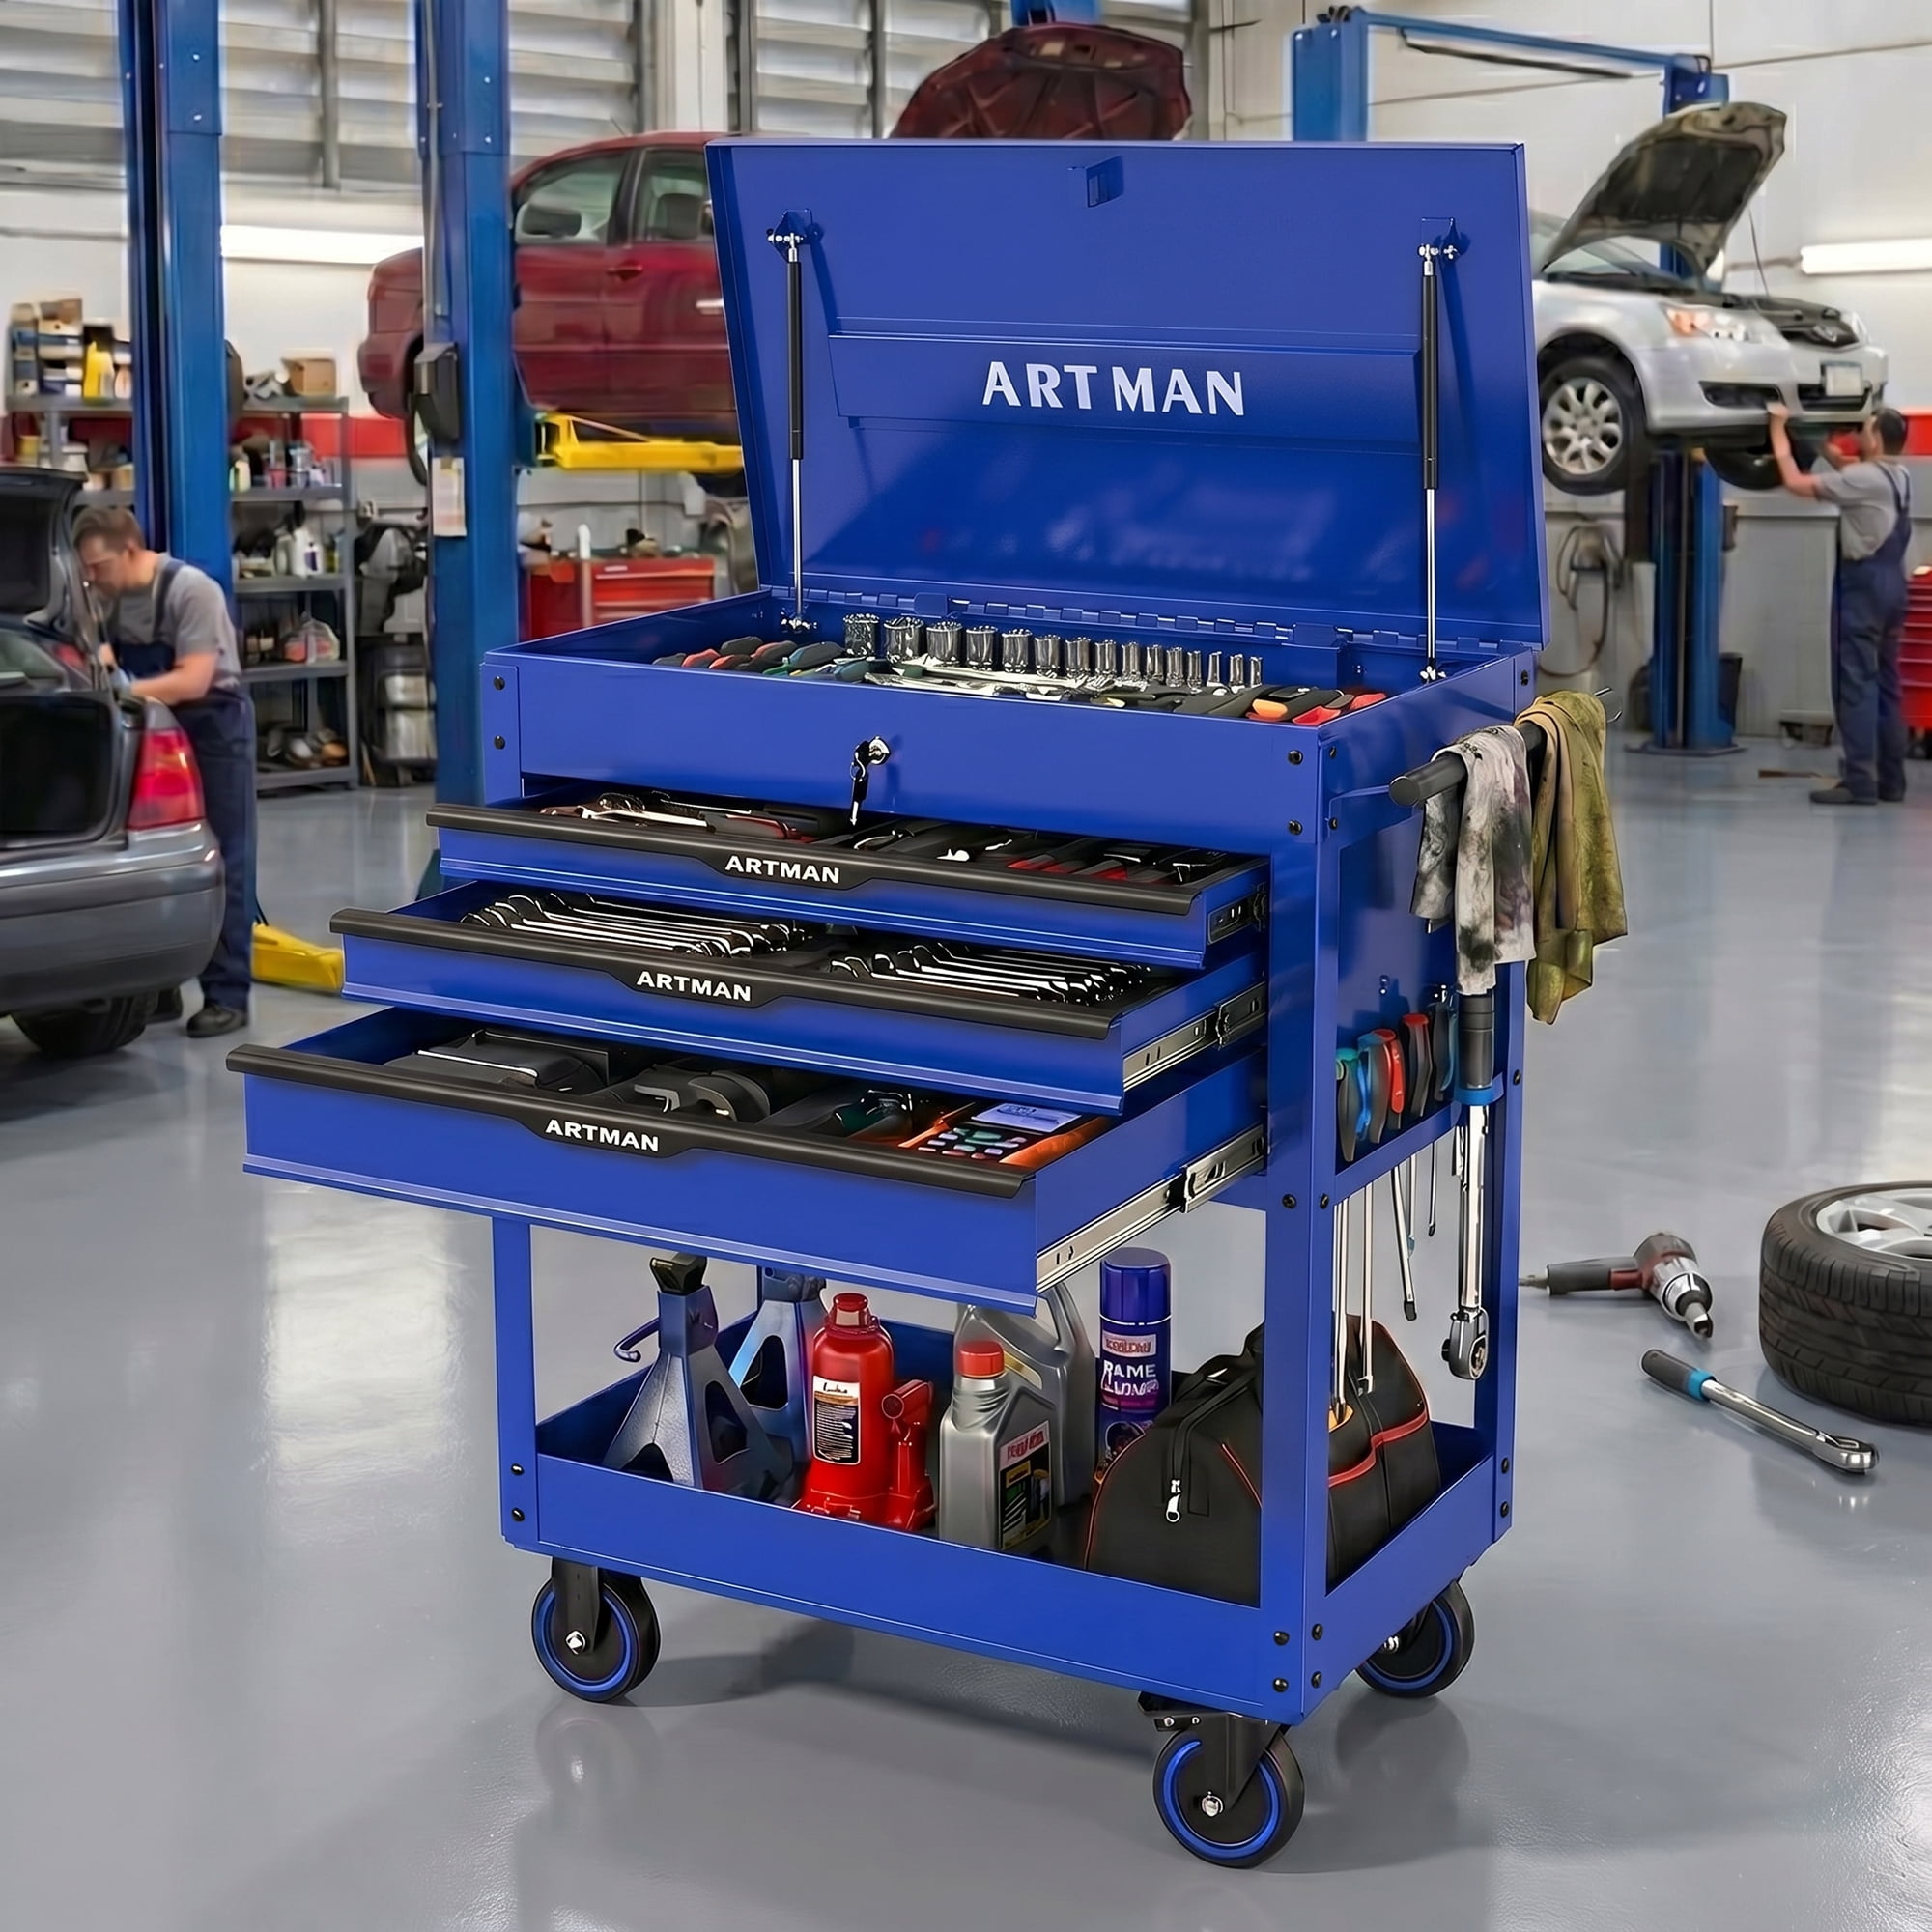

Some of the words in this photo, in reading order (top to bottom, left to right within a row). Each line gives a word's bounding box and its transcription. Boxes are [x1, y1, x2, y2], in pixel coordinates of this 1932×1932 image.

[724, 855, 840, 884] ARTMAN
[636, 971, 751, 1002] ARTMAN
[545, 1119, 660, 1153] ARTMAN
